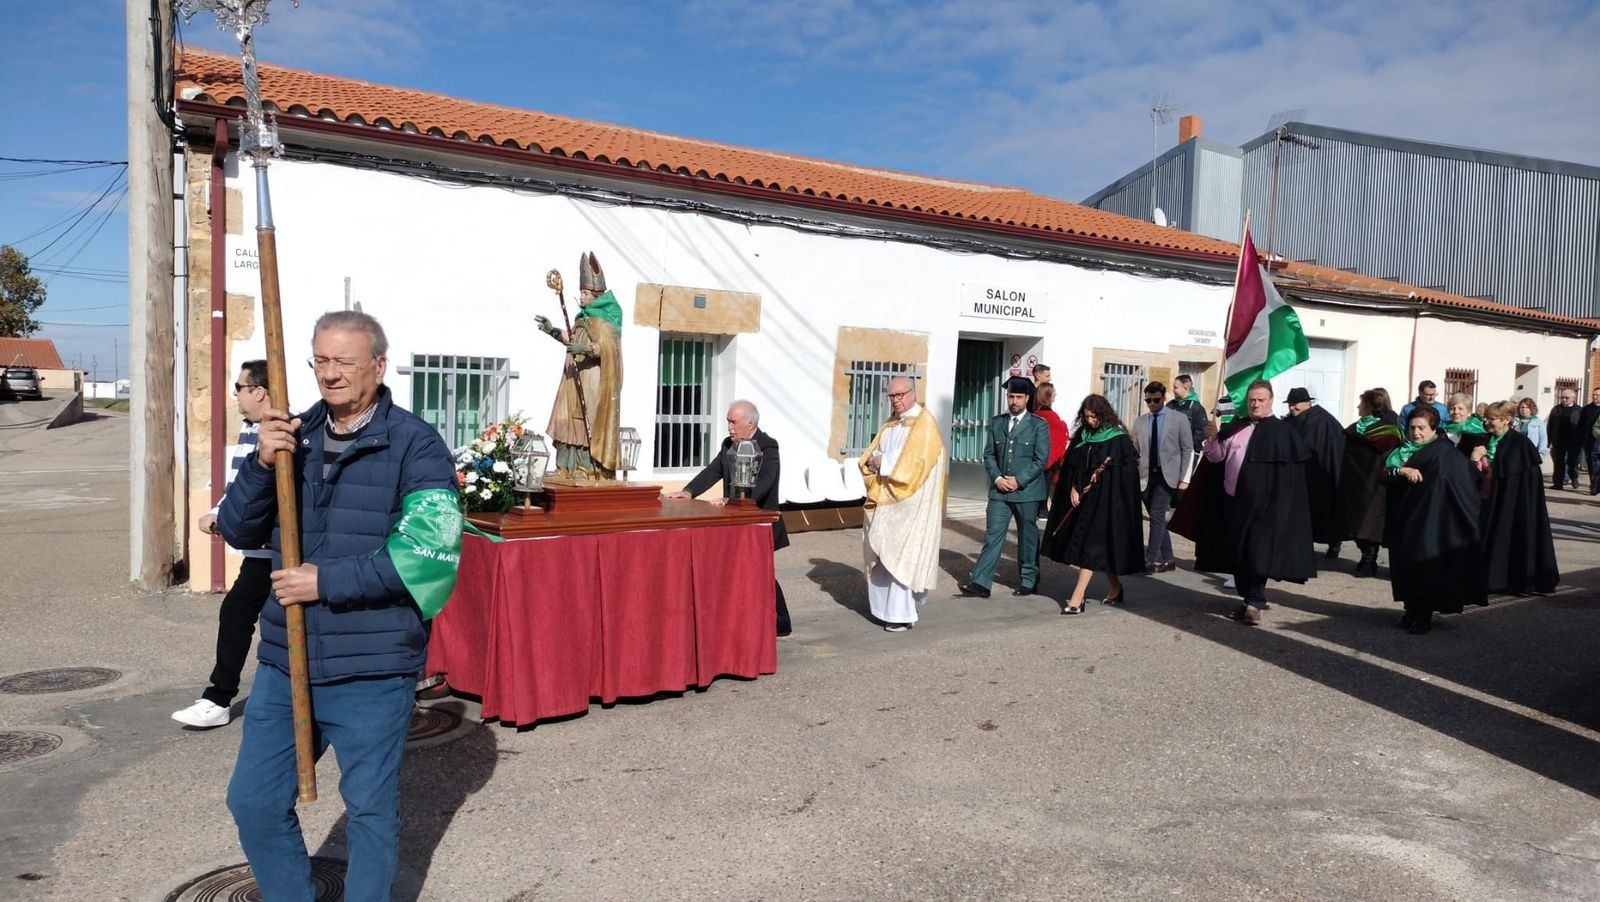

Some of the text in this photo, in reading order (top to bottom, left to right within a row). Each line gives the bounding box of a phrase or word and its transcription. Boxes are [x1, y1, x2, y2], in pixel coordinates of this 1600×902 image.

[235, 248, 259, 258] CALL
[234, 260, 259, 270] LARG
[986, 288, 1026, 303] SALON
[974, 302, 1035, 318] MUNICIPAL
